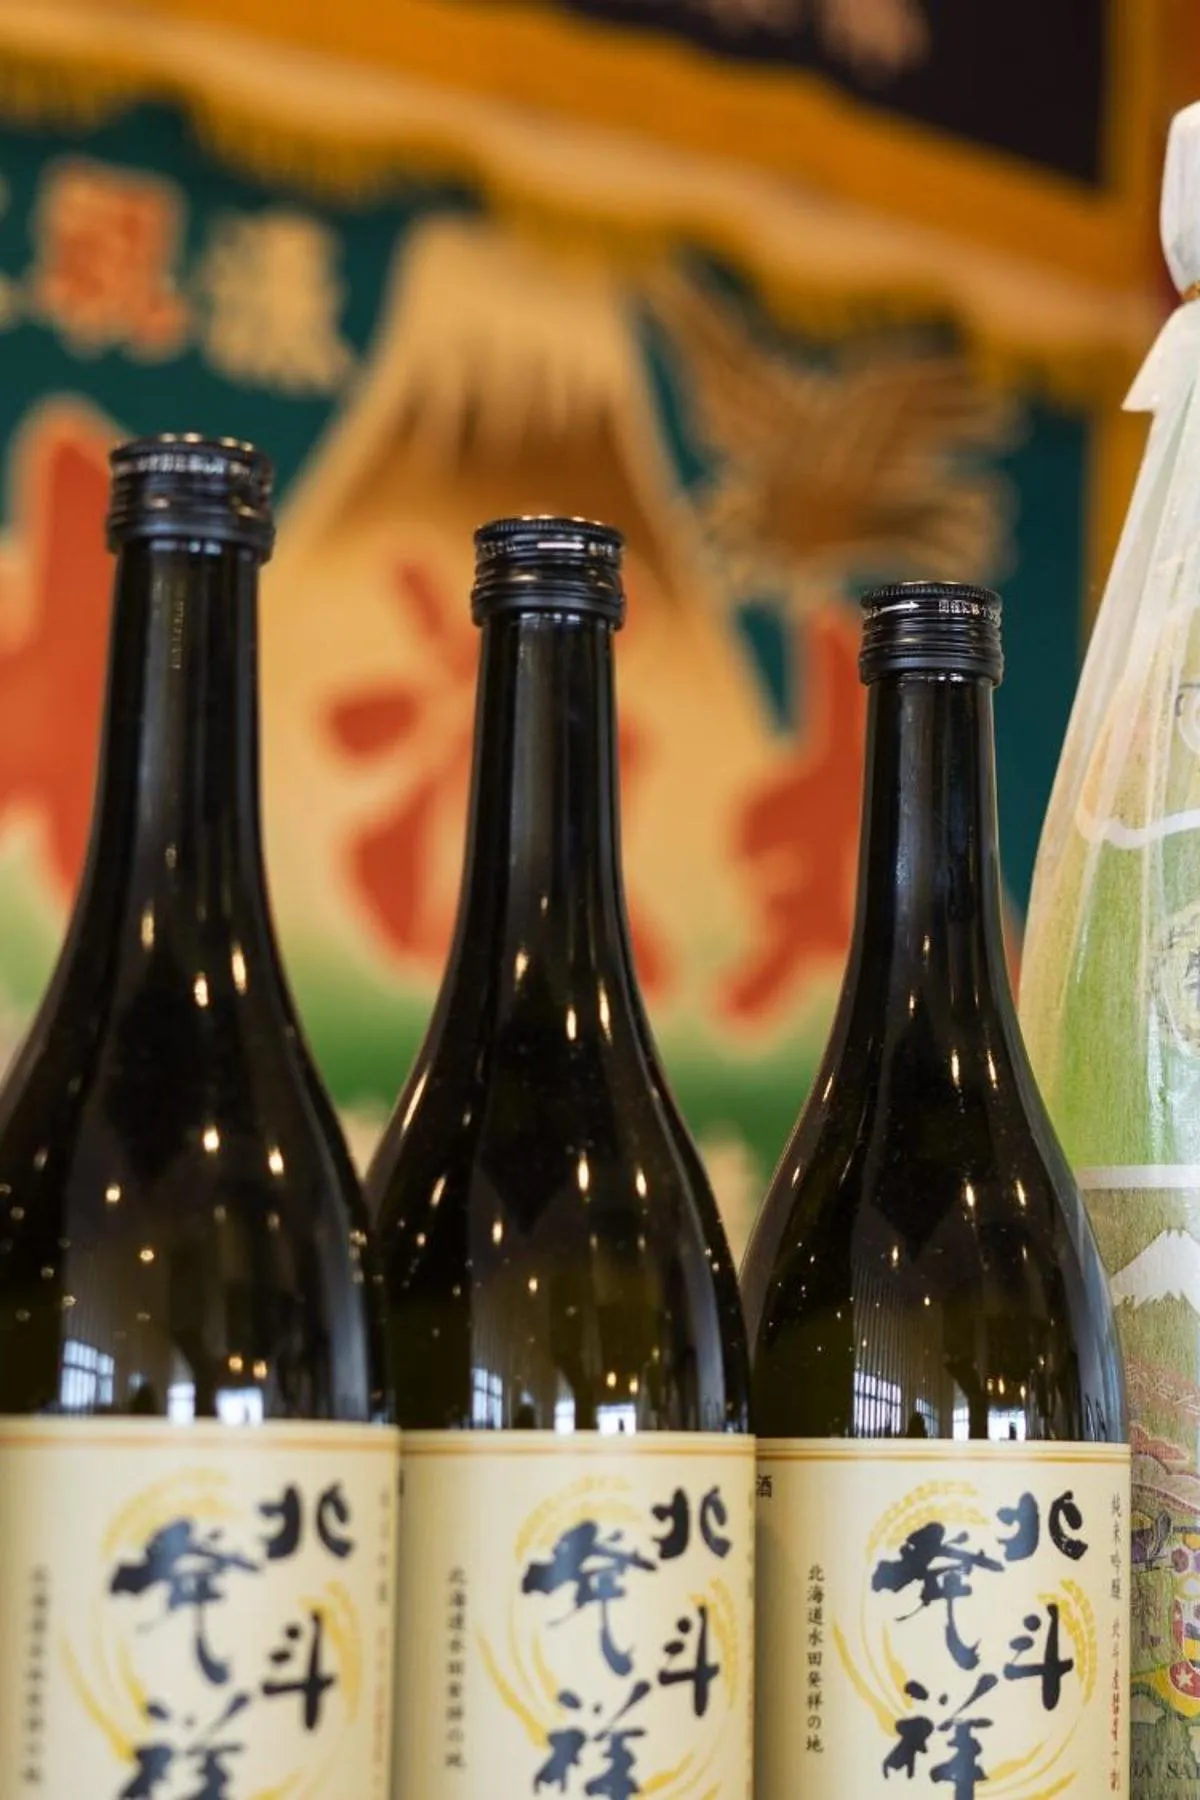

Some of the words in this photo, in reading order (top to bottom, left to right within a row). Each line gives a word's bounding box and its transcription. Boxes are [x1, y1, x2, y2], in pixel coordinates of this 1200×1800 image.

[258, 1480, 355, 1732] 北斗
[651, 1487, 732, 1717] 北斗
[806, 1564, 825, 1754] 北海道水田発祥の地
[996, 1490, 1089, 1710] 北斗
